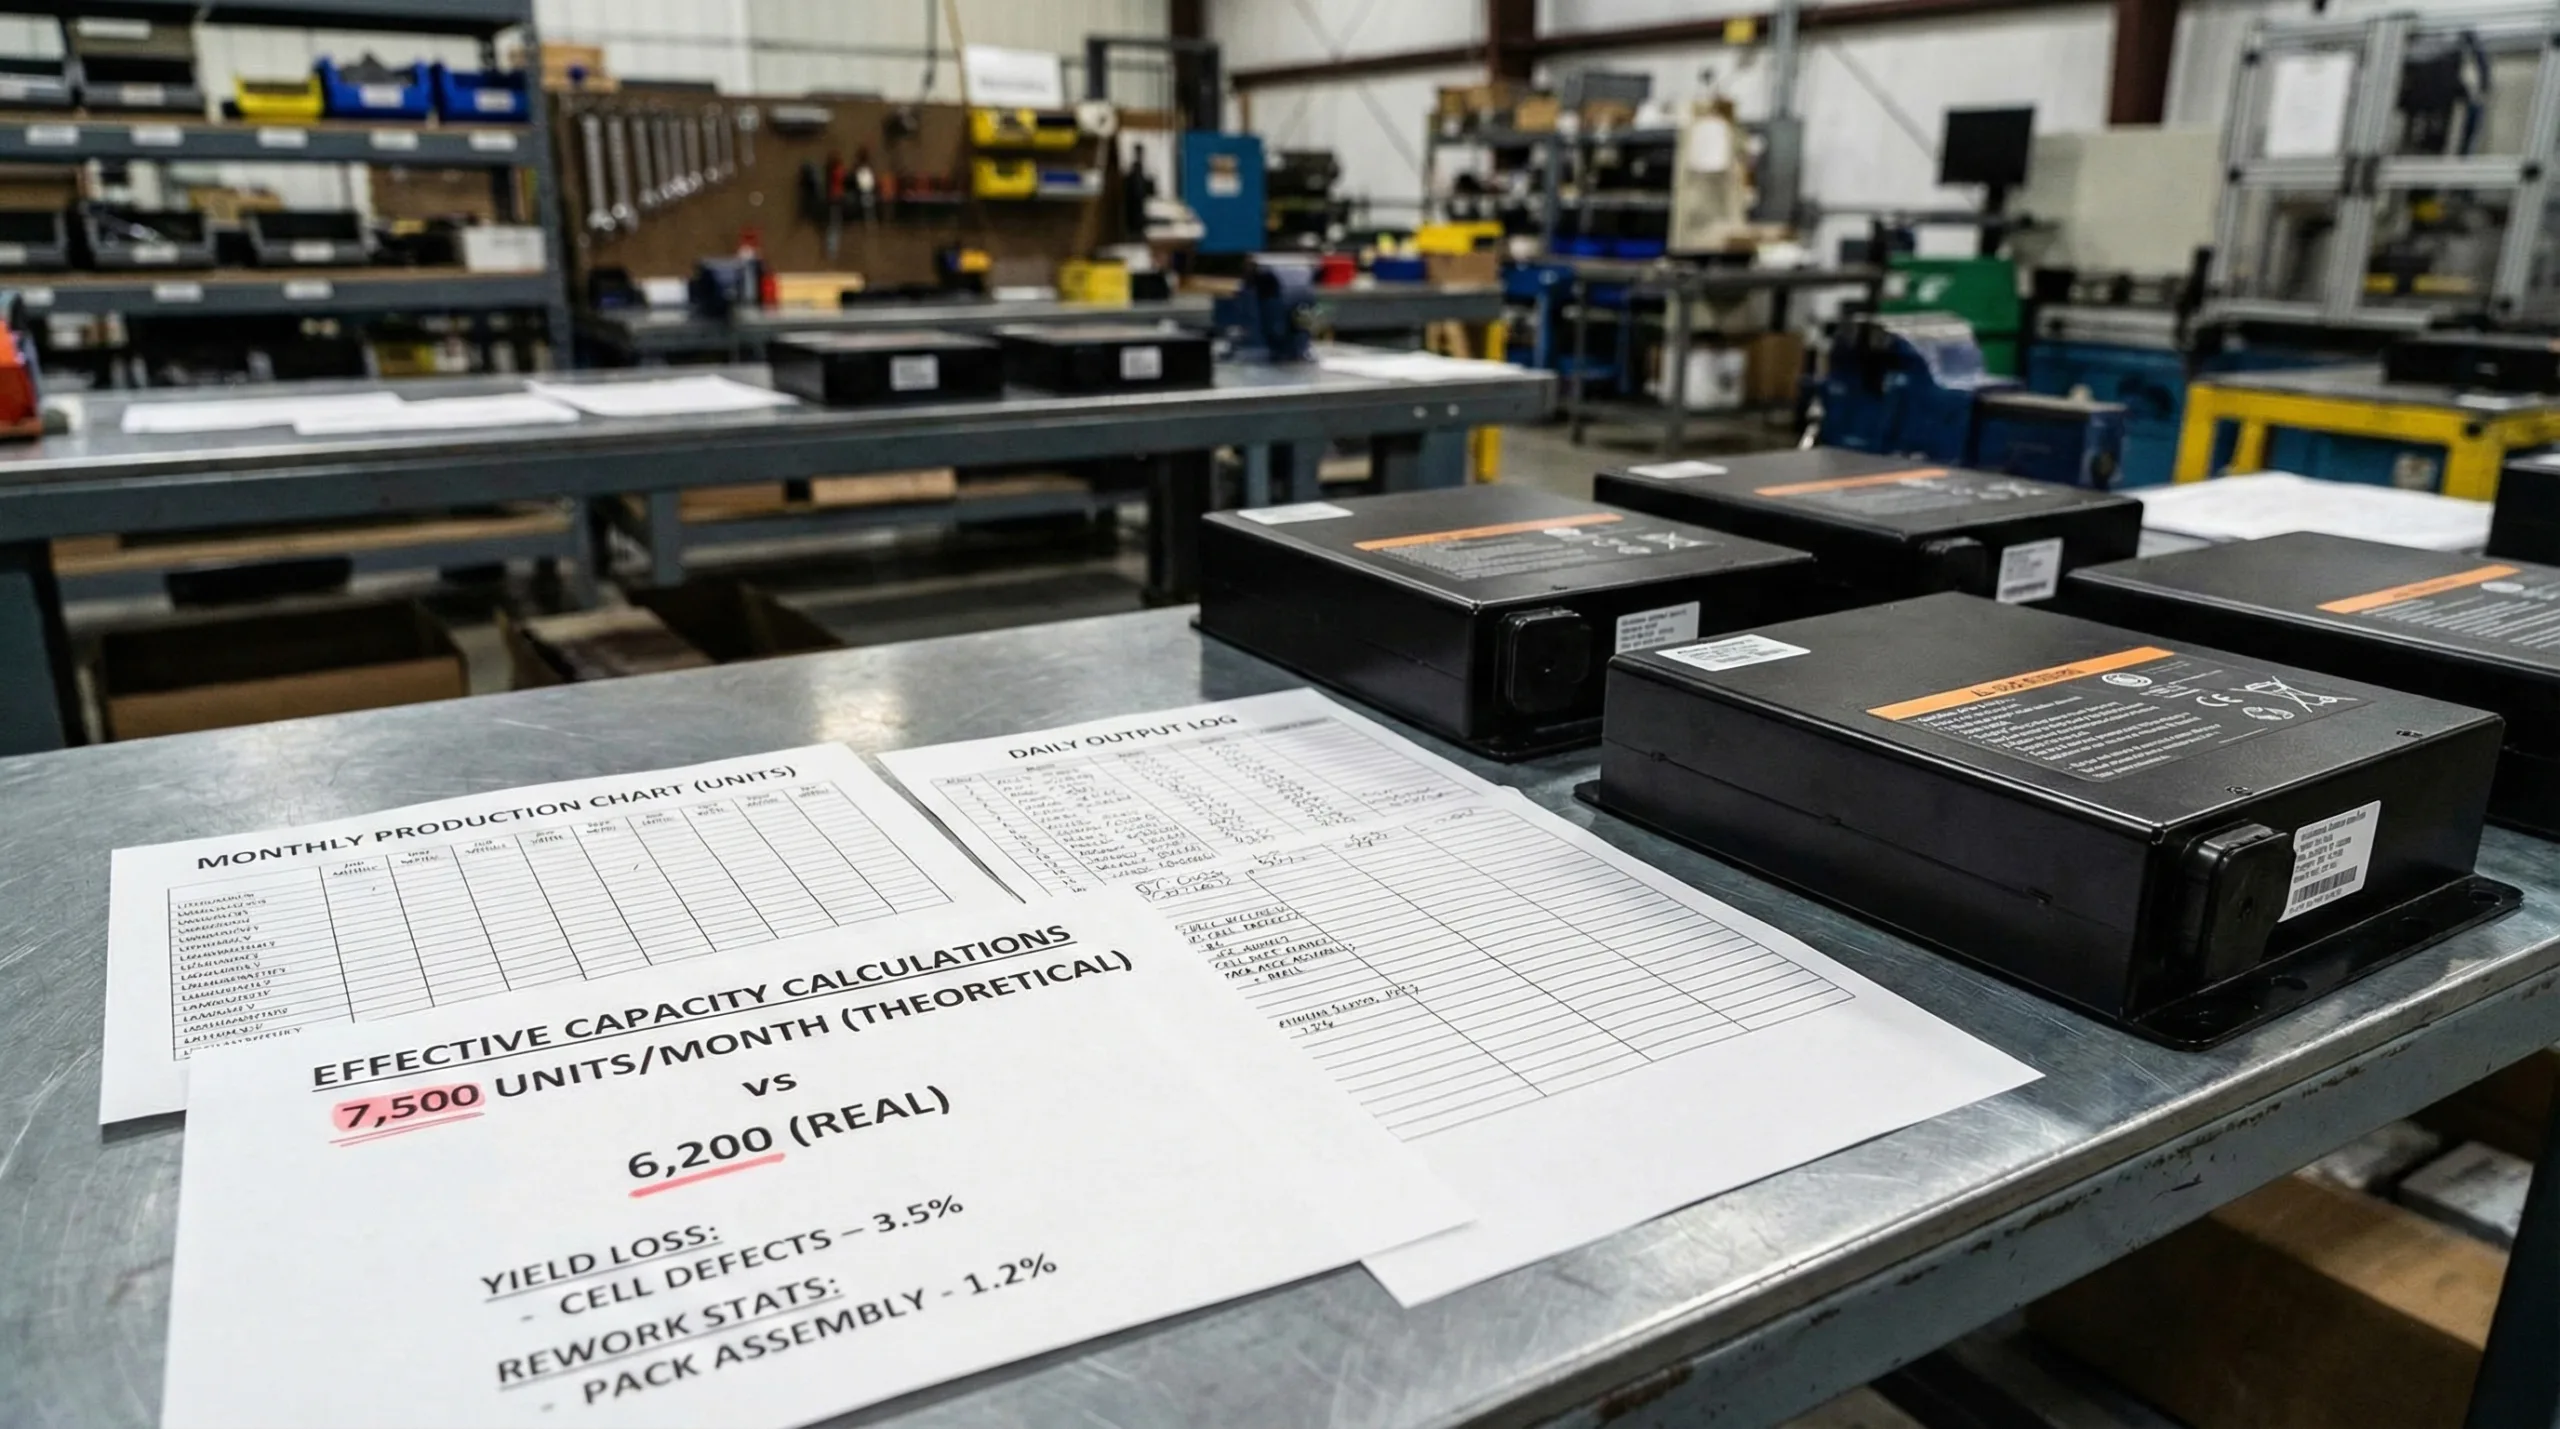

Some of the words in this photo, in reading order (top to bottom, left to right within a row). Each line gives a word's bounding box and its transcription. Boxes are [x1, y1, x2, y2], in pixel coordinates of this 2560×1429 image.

[1008, 739, 1077, 760] DAILY
[1085, 723, 1182, 748] OUTPUT
[1186, 714, 1238, 731] LOG
[197, 834, 365, 870] MONTHLY
[374, 798, 582, 843] PRODUCTION
[590, 782, 684, 809] CHART
[693, 765, 797, 794] (UNITS)
[314, 1024, 552, 1087] EFFECTIVE
[565, 984, 767, 1039] CAPACITY
[782, 924, 1072, 998] CALCULATIONS
[341, 1082, 480, 1129] 7,500
[495, 1014, 830, 1098] UNITS/MONTH
[841, 949, 1133, 1033] (THEORETICAL)
[628, 1126, 774, 1179] 6,200
[789, 1084, 951, 1148] (REAL)
[480, 1252, 597, 1296] YIELD
[610, 1223, 720, 1266] LOSS:
[560, 1277, 654, 1316] CELL
[662, 1228, 832, 1290] DEFECTS
[873, 1193, 964, 1235] 3.5%
[497, 1313, 690, 1384] REWORK
[703, 1275, 842, 1329] STATS:
[583, 1355, 699, 1405] PACK
[715, 1288, 927, 1369] ASSEMBLY
[963, 1251, 1059, 1297] 1.2%
